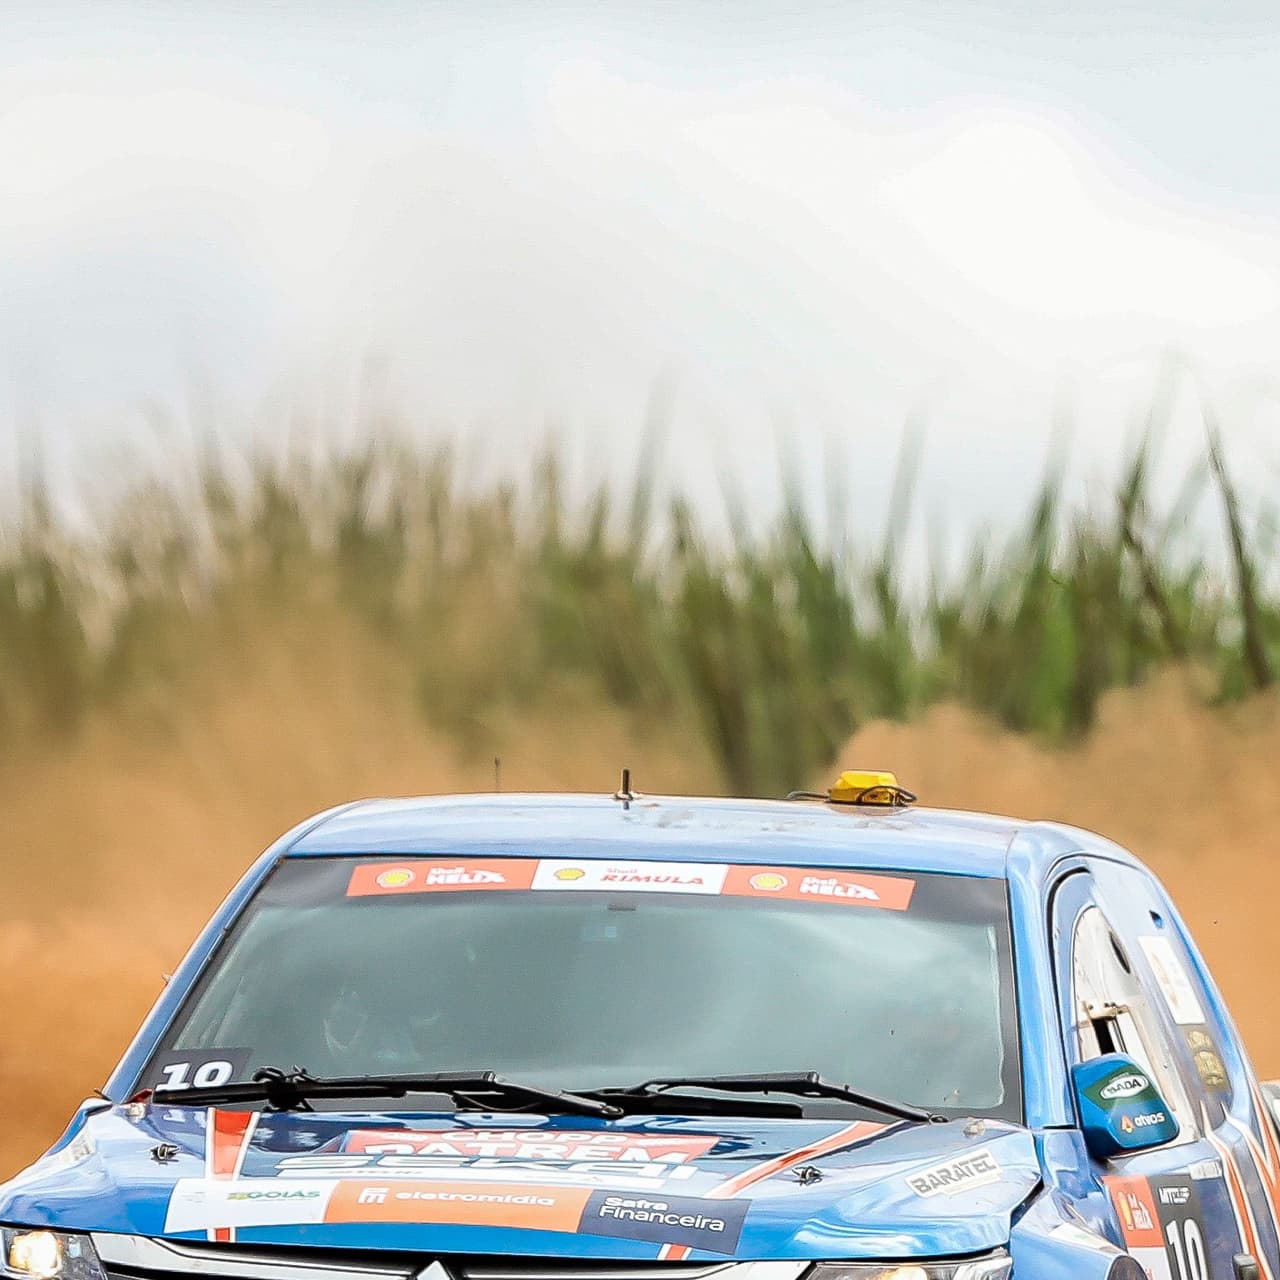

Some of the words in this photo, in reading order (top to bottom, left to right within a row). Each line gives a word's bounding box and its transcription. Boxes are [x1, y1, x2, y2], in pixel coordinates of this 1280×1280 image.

[425, 871, 506, 885] HELIX
[600, 873, 705, 885] RIMULA
[799, 884, 881, 900] HELIX
[155, 1060, 233, 1092] 10
[441, 1129, 629, 1147] CHOPP
[274, 1154, 700, 1182] SEKAI
[604, 1196, 668, 1211] Safra
[598, 1205, 726, 1233] Financeira
